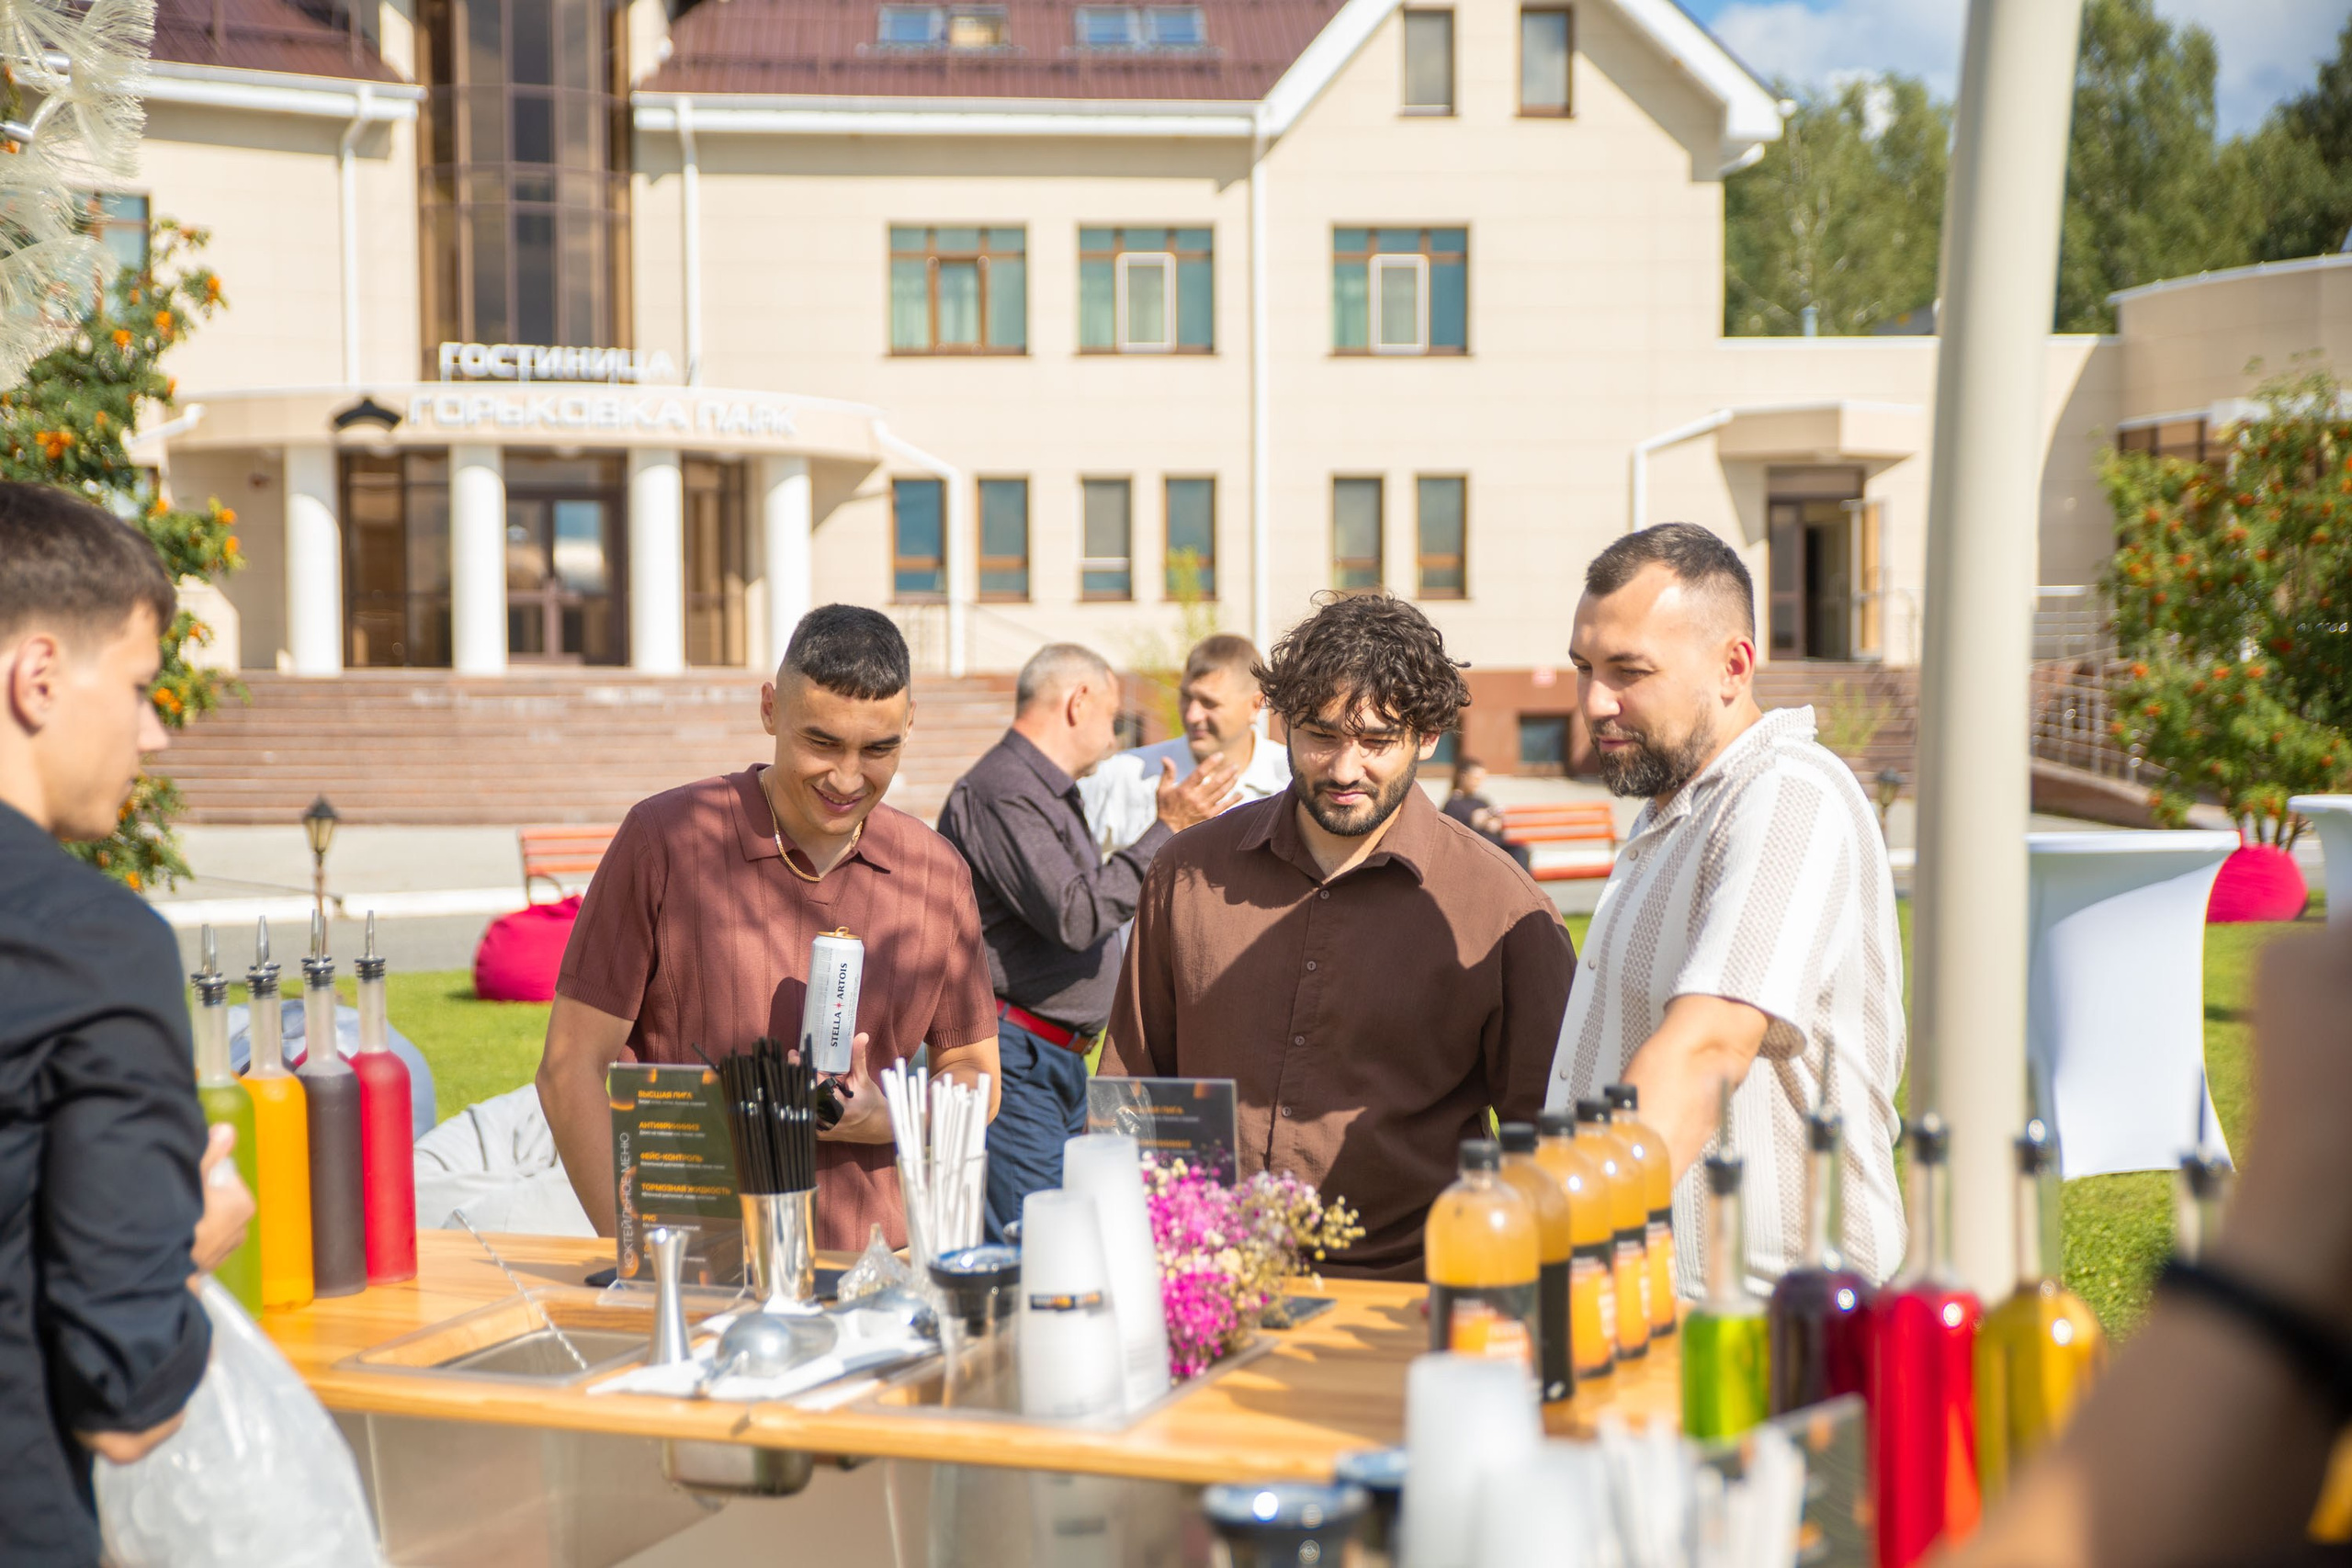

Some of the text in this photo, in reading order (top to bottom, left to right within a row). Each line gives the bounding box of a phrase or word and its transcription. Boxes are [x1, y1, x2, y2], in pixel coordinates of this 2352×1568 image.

[439, 342, 674, 378] ГОСТИНИЦА
[409, 395, 797, 434] ГОРЬКОВКА ПАРК
[831, 963, 847, 1047] STELLA ARTOIS
[619, 1132, 634, 1269] КОКТЕЙЛЬНОЕ МЕНЮ
